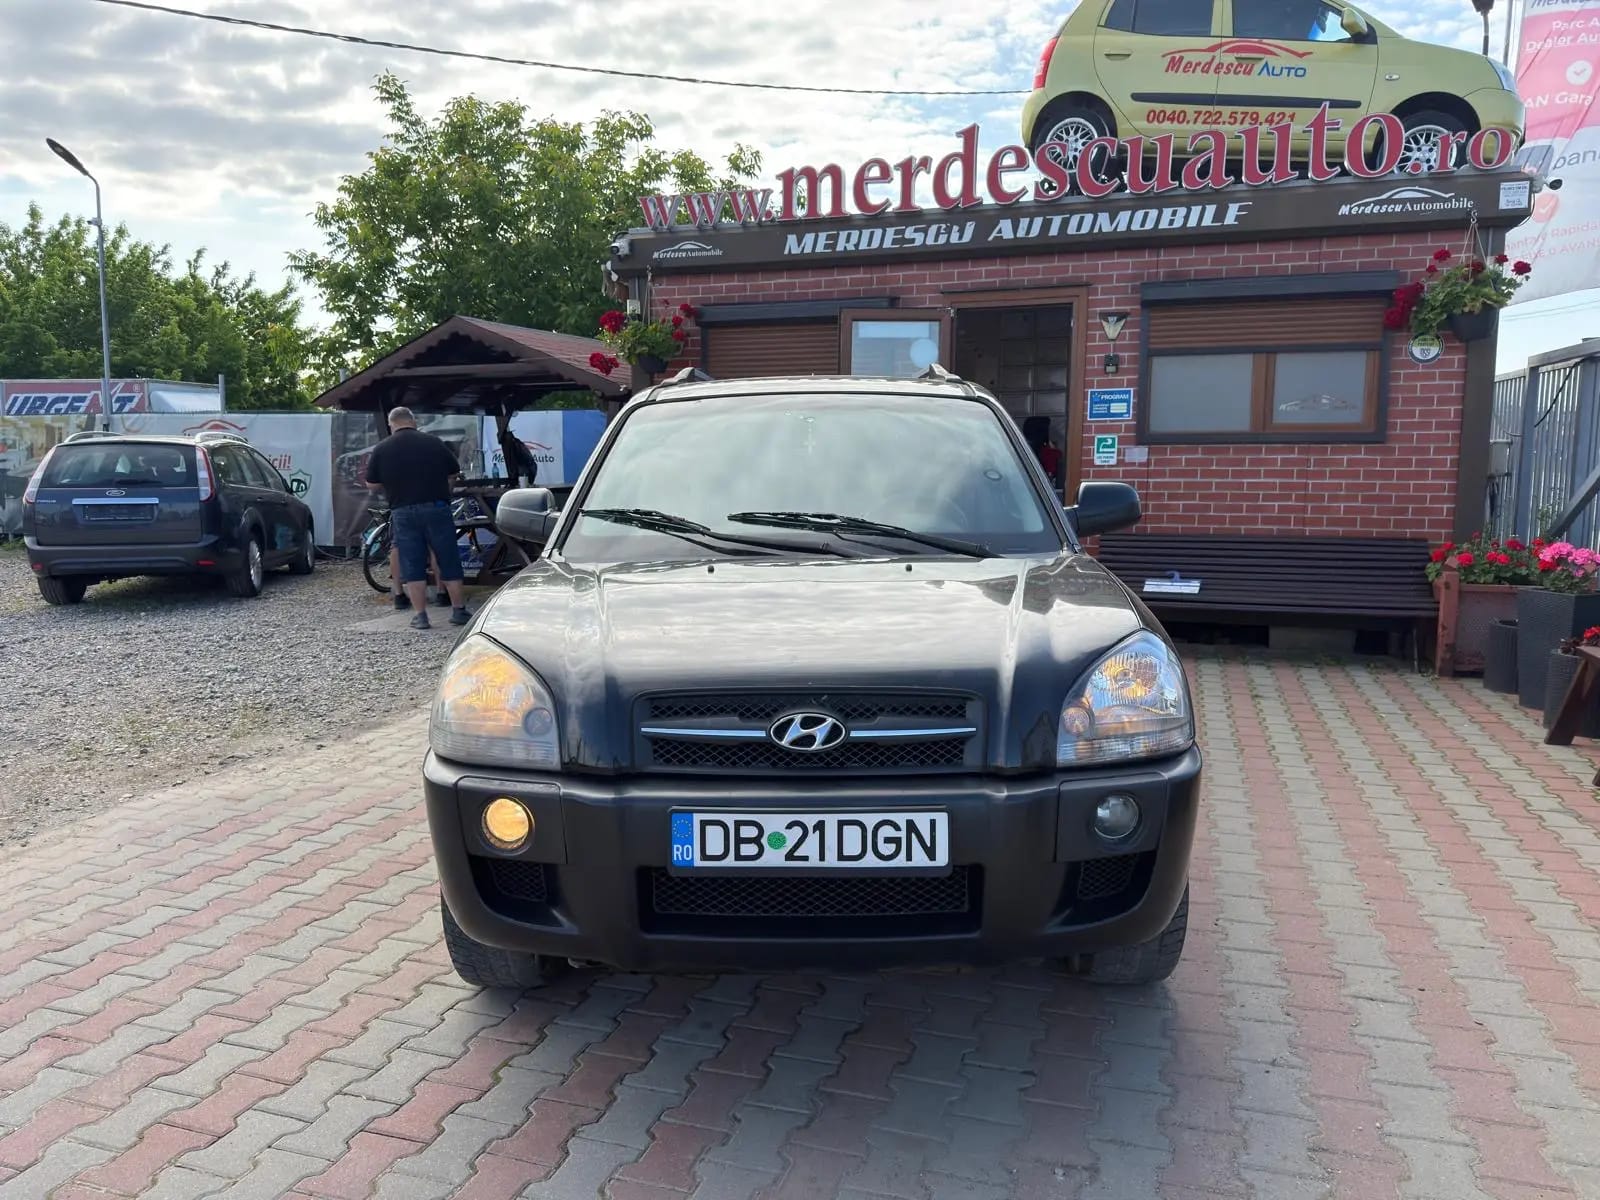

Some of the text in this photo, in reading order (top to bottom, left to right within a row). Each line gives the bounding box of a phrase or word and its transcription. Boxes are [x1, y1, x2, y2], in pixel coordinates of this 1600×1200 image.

[1165, 55, 1307, 78] Merdescu AUTO
[1146, 109, 1296, 127] 0040.722.579.421
[638, 101, 1513, 229] www.merdescuauto.ro
[1338, 197, 1474, 216] Merdescu Automobile
[784, 201, 1253, 255] MERDESCU AUTOMOBILE
[699, 818, 937, 862] DB 21 DGN
[673, 845, 692, 861] RO
